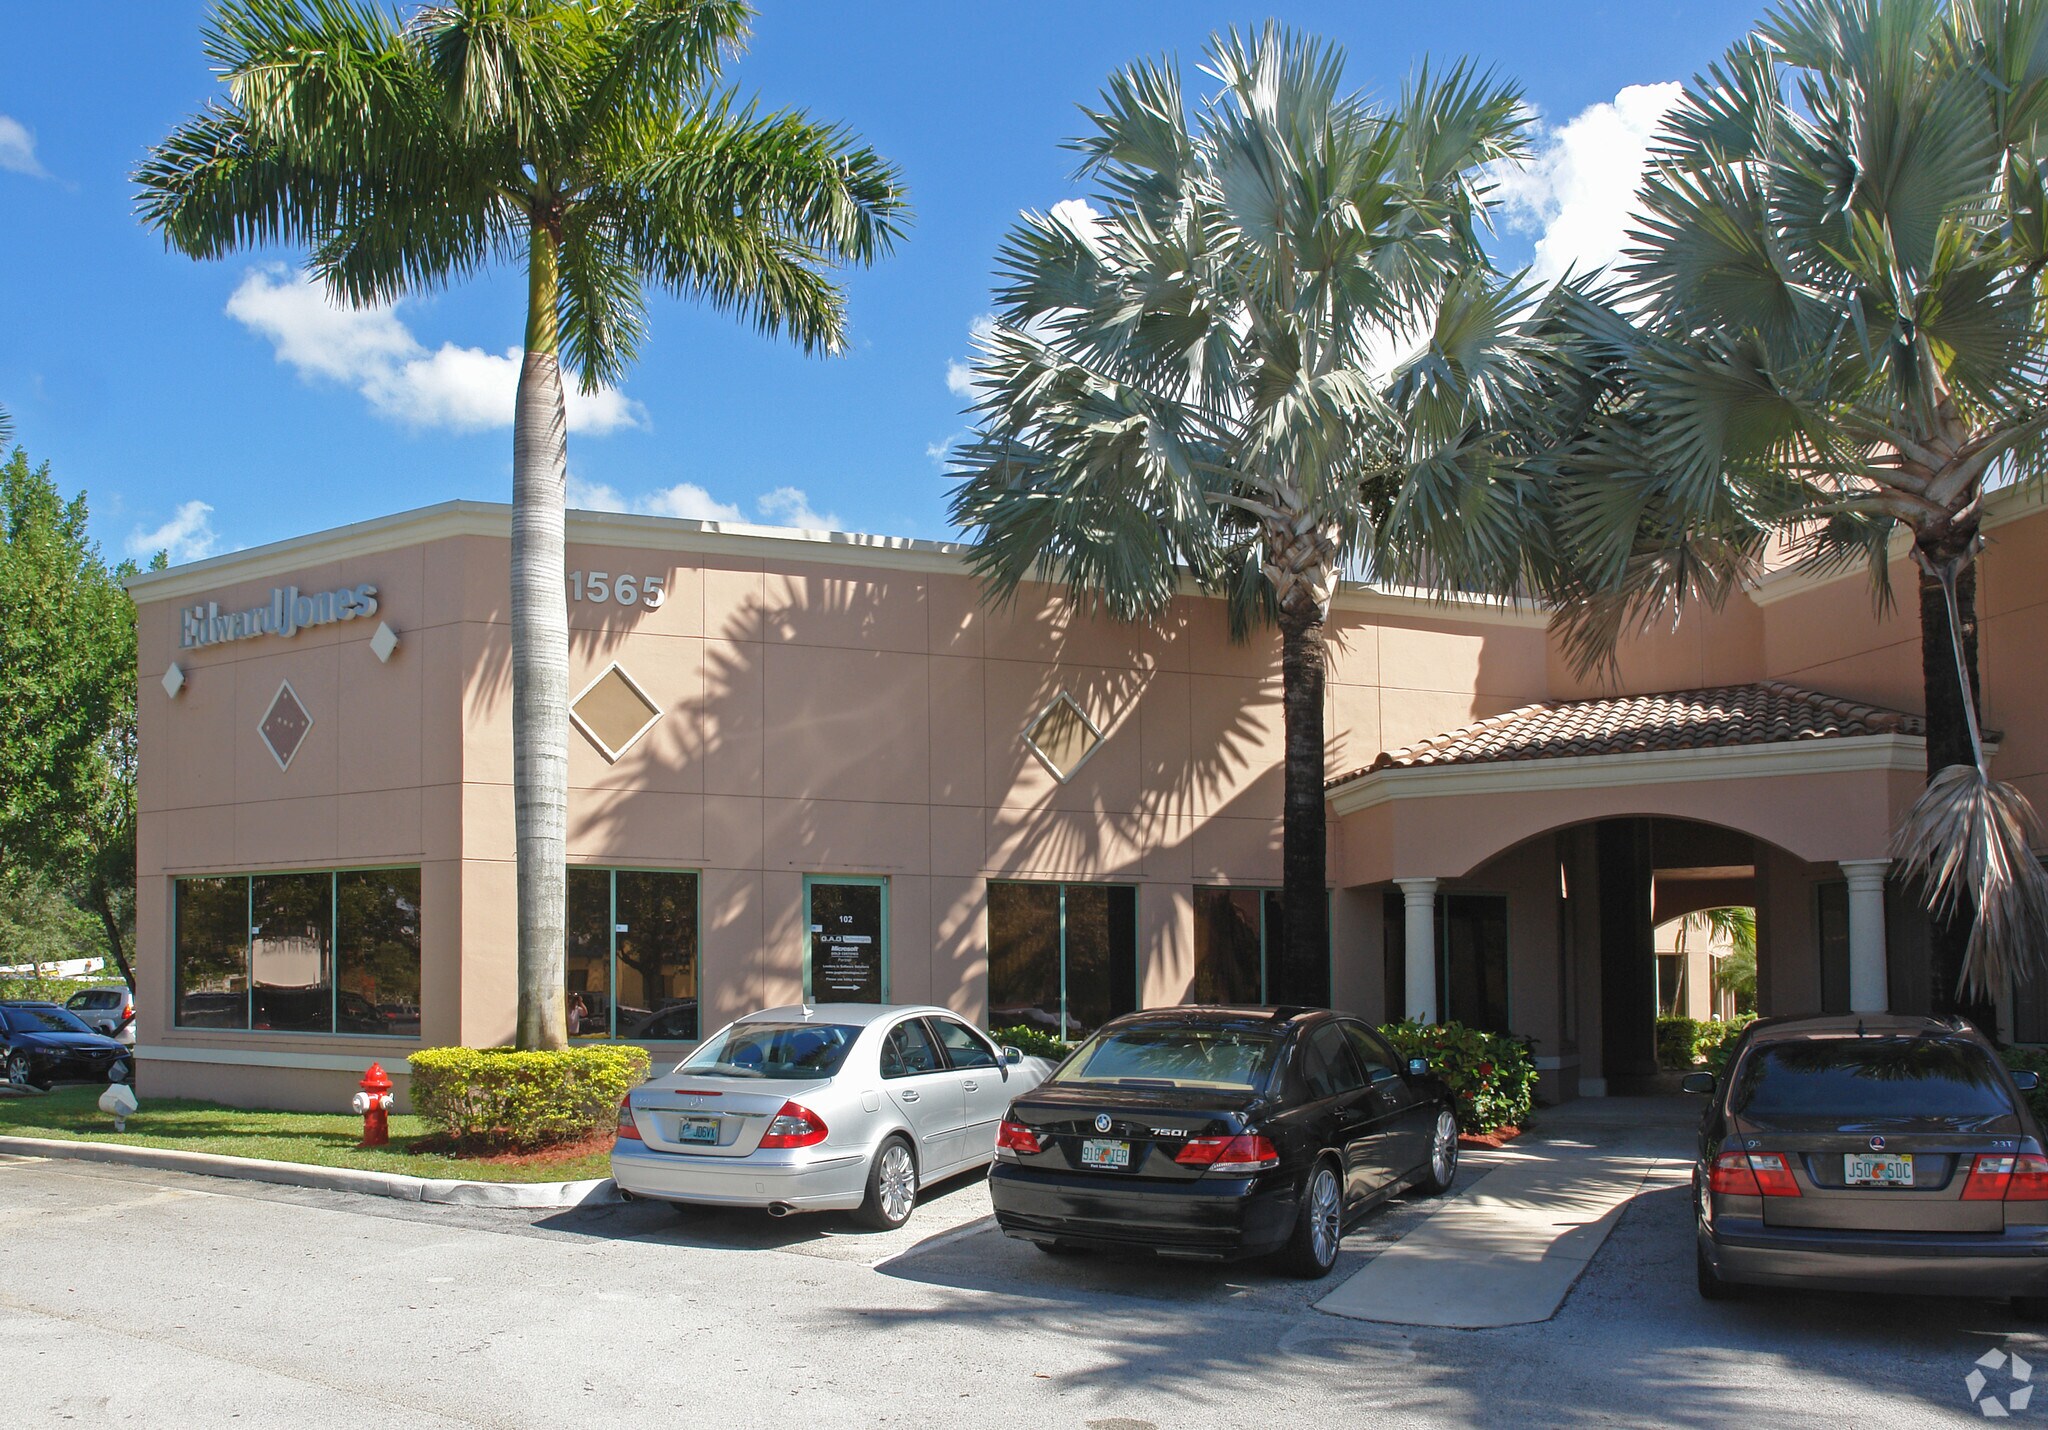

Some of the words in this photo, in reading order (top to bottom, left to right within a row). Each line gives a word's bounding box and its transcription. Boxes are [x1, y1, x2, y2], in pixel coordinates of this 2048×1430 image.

[569, 570, 665, 608] 1565
[839, 915, 853, 923] 102
[1083, 1147, 1100, 1161] 918
